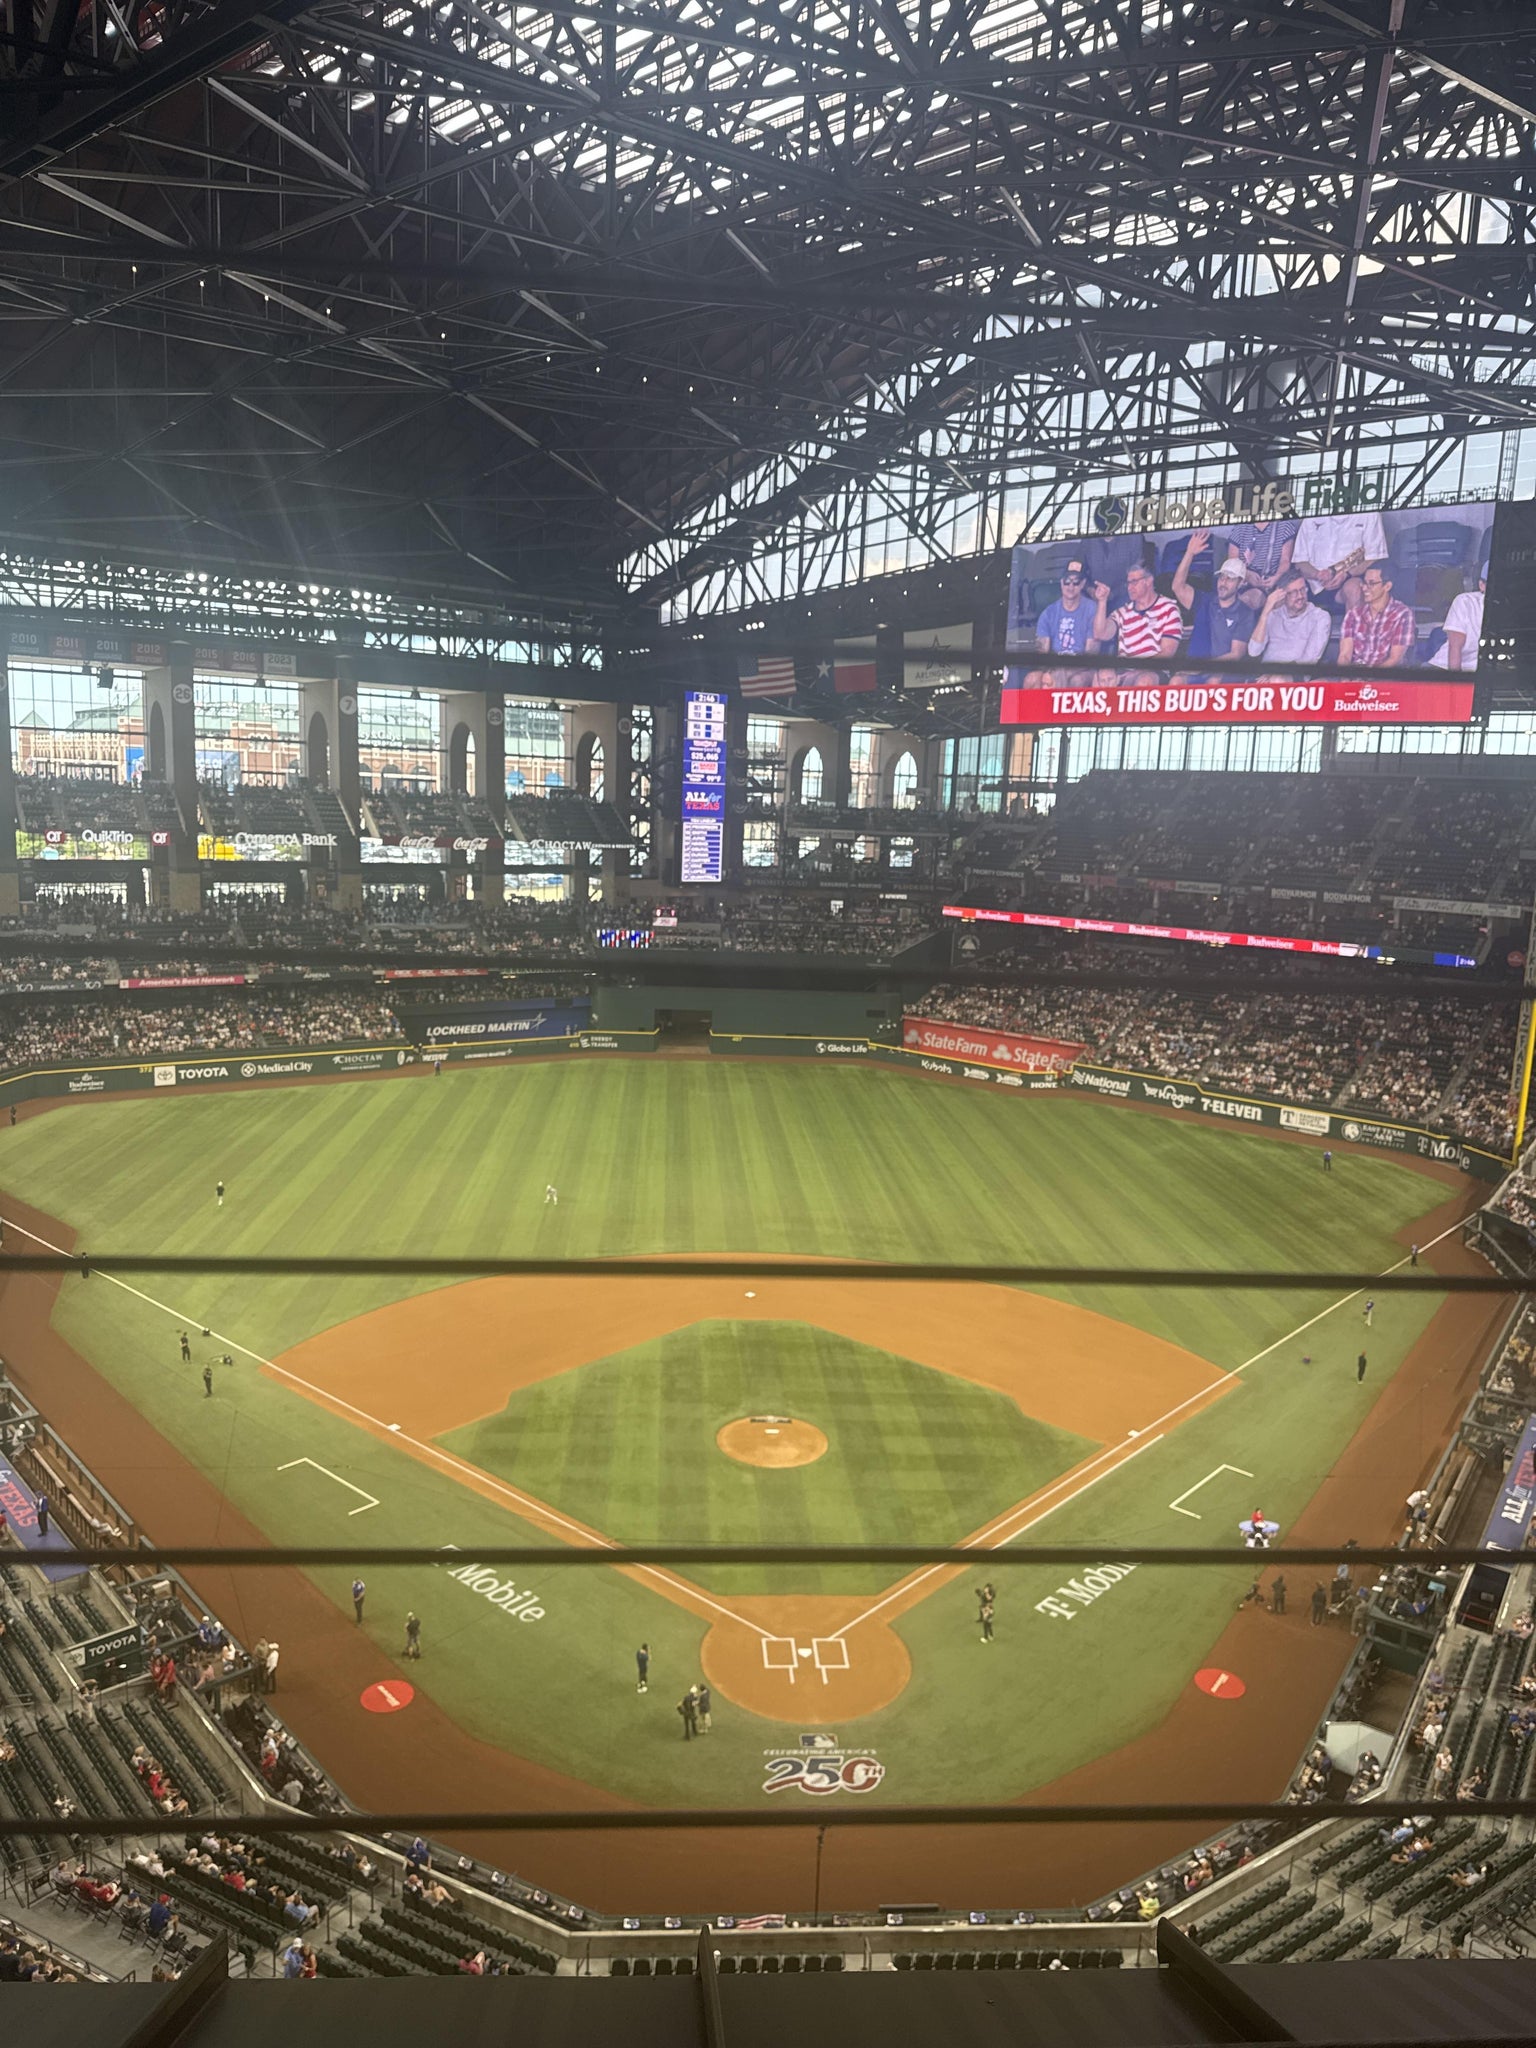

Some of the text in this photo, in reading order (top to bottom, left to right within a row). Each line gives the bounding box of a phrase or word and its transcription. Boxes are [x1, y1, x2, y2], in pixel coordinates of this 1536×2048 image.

[1134, 472, 1382, 527] Globe Life Field
[11, 633, 37, 645] 2010
[56, 637, 79, 648] 2011
[96, 640, 119, 651] 2011
[136, 643, 161, 654] 2012
[195, 648, 218, 659] 2015
[232, 651, 257, 662] 2016
[268, 655, 292, 665] 2023
[175, 688, 191, 699] 26
[698, 694, 716, 702] 2:46
[345, 700, 353, 710] 7
[1051, 687, 1323, 715] TEXAS, THIS BUD'S FOR YOU
[1334, 699, 1399, 712] Budweiser
[685, 792, 722, 806] ALL for
[685, 802, 720, 811] TEXAS
[46, 830, 62, 843] QT
[82, 829, 133, 843] QuikTrip
[153, 832, 168, 844] QT
[302, 833, 338, 846] Bank
[536, 839, 592, 850] CHOCTAW
[1060, 874, 1081, 883] 105.3
[1271, 887, 1317, 898] BODYARMOR
[1323, 892, 1371, 903] BODYARMOR
[1074, 919, 1114, 932] Budweiser
[1129, 924, 1170, 937] Budweiser
[1186, 930, 1230, 944] Budweiser
[1247, 935, 1295, 949] Budweiser
[139, 976, 235, 987] America's Best Network
[426, 1021, 531, 1036] LOCKHEED MARTIN
[827, 1044, 852, 1053] Globe
[852, 1045, 868, 1053] Life
[338, 1053, 383, 1064] CHOCTAW
[178, 1067, 229, 1080] TOYOTA
[257, 1061, 313, 1074] Medical City
[921, 1060, 952, 1074] Kubota
[1084, 1073, 1131, 1092] National
[1158, 1085, 1196, 1109] Kroger
[1362, 1125, 1406, 1138] EAST TEXAS
[1373, 1133, 1392, 1143] A&M
[0, 1481, 38, 1527] TEXAS
[447, 1563, 546, 1622] Mobile
[88, 1633, 137, 1657] TOYOTA
[762, 1755, 881, 1796] 250
